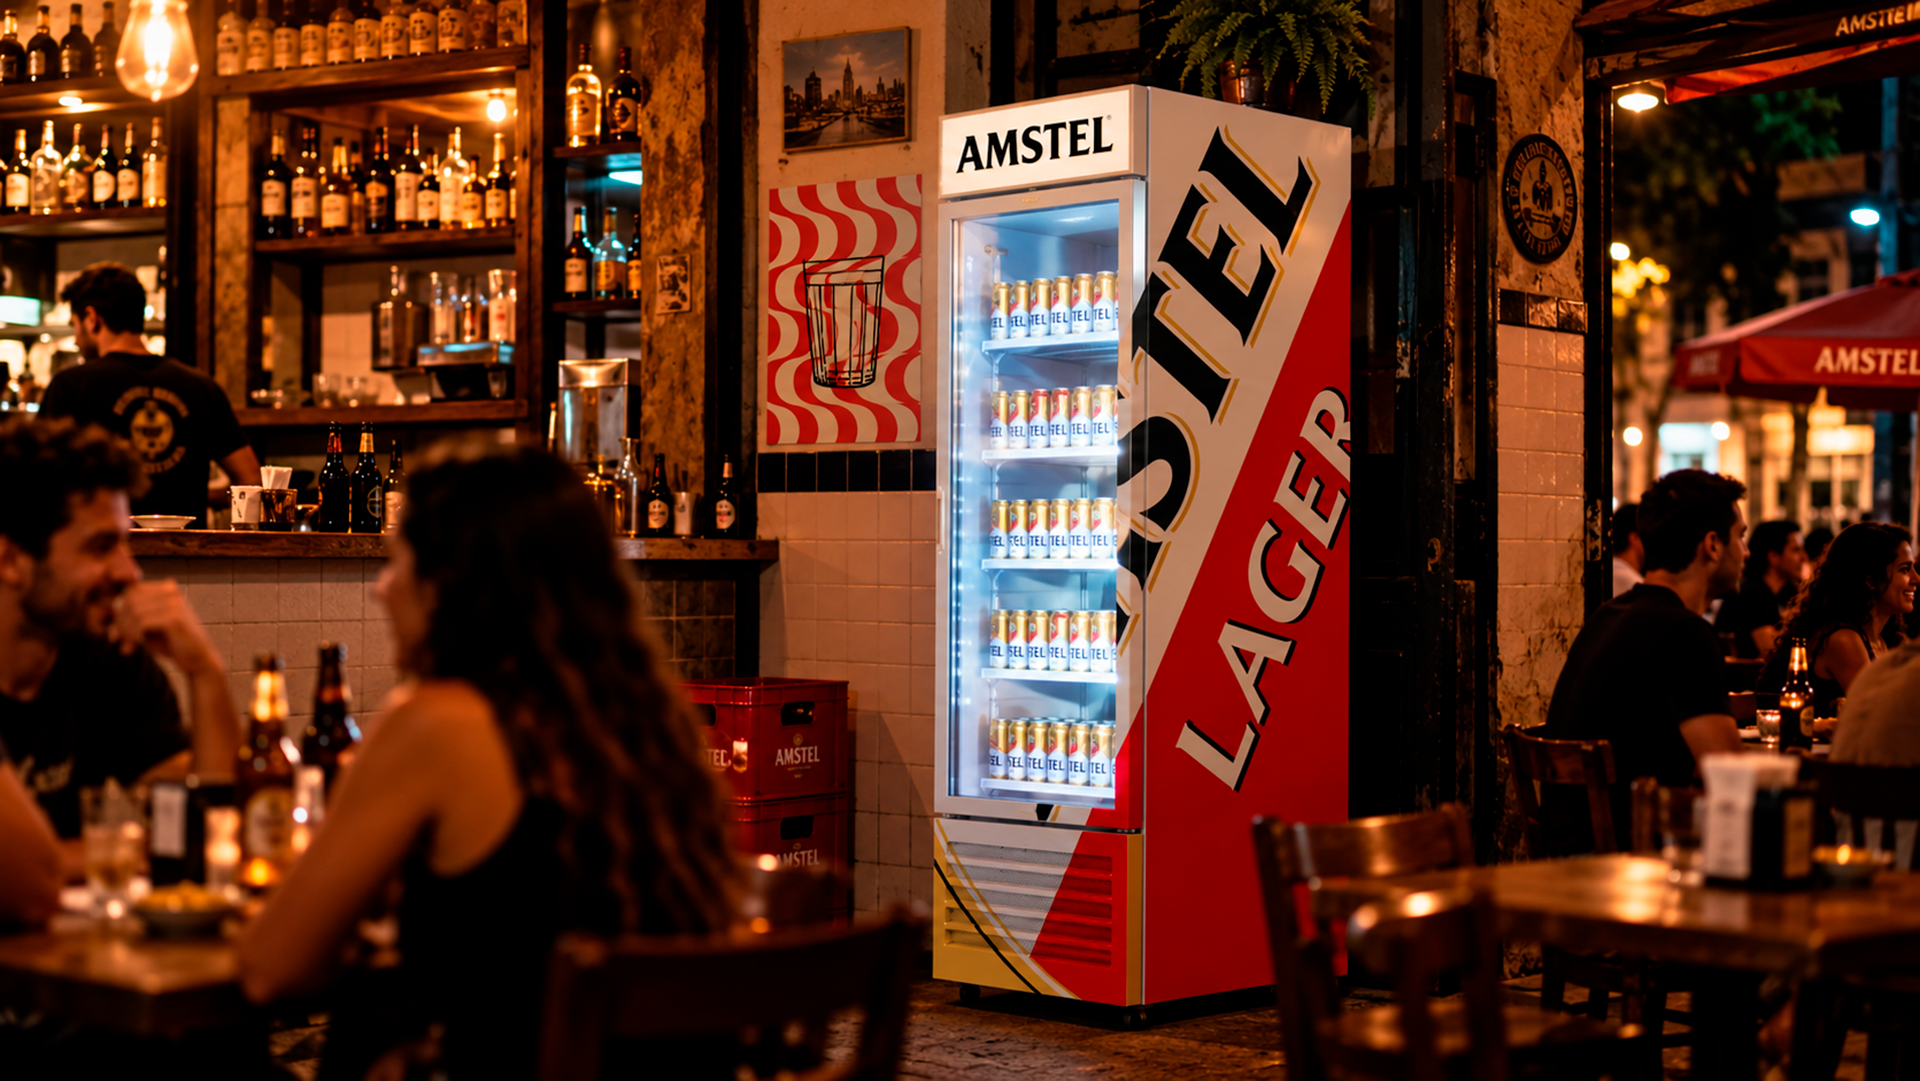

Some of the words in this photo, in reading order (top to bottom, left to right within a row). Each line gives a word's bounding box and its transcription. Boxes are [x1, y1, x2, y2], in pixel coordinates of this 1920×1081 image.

[956, 116, 1113, 174] AMSTEL
[1072, 310, 1090, 321] TEL
[1093, 308, 1110, 320] TEL
[1092, 422, 1110, 434] TEL
[1030, 536, 1046, 546] TEL
[1049, 536, 1067, 546] TEL
[1070, 536, 1088, 546] TEL
[1092, 535, 1108, 546] TEL
[1176, 386, 1351, 792] LAGER
[775, 745, 820, 767] AMSTEL
[1048, 760, 1065, 770] TEL
[1069, 760, 1086, 772] TEL
[1090, 762, 1106, 774] TEL
